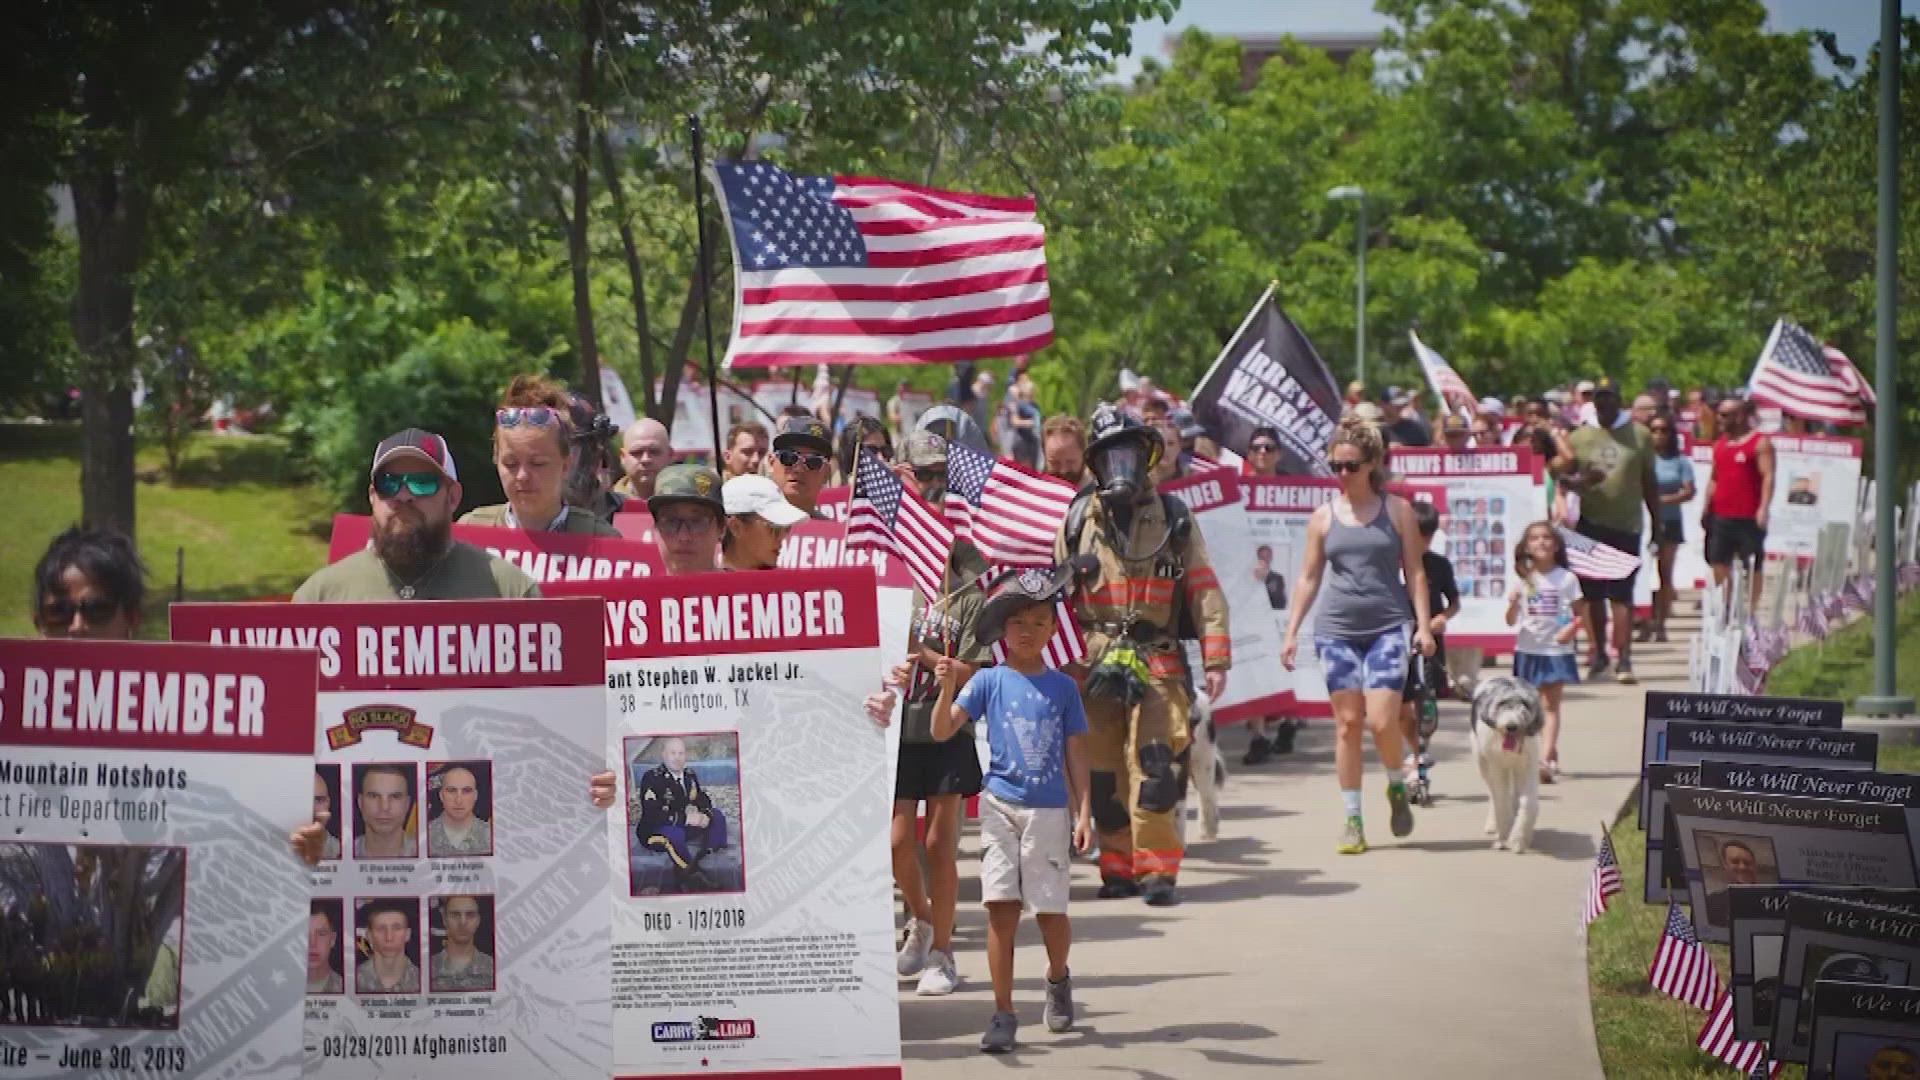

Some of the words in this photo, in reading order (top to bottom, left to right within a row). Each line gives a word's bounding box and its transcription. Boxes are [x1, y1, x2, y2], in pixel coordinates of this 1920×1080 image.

[661, 589, 845, 643] REMEMBER
[357, 623, 563, 677] REMEMBER
[608, 670, 632, 689] ant
[638, 667, 699, 690] Stephen
[704, 664, 721, 683] W.
[728, 661, 778, 684] Jackel
[785, 661, 804, 681] Jr.
[22, 667, 266, 737] REMEMBER
[620, 694, 636, 713] 38
[660, 692, 728, 714] Arlington,
[735, 688, 750, 706] TX
[1667, 699, 1691, 713] We
[1695, 700, 1727, 716] Will
[1730, 702, 1773, 718] Never
[1777, 704, 1823, 723] Forget
[1689, 730, 1715, 744] We
[1721, 732, 1754, 748] Will
[1757, 734, 1803, 751] Never
[1806, 737, 1856, 756] Forget
[0, 759, 89, 787] Mountain
[97, 763, 188, 790] Hotshots
[1726, 770, 1755, 787] We
[1760, 773, 1802, 791] Will
[1802, 777, 1855, 796] Never
[1857, 781, 1912, 802] Forget
[19, 793, 51, 819] Fire
[59, 795, 167, 825] Department
[1693, 797, 1723, 812] We
[1725, 799, 1766, 816] Will
[1768, 802, 1821, 821] Never
[1823, 807, 1881, 828] Forget
[644, 912, 672, 931] DIED
[688, 908, 745, 931] 1/3/2018
[1823, 911, 1860, 929] We
[1866, 918, 1919, 938] Will
[1852, 993, 1891, 1011] We
[653, 1025, 693, 1039] CARRY
[720, 1023, 751, 1037] LOAD
[0, 1042, 27, 1068] ire
[59, 1044, 102, 1070] June
[109, 1045, 136, 1073] 30,
[144, 1046, 186, 1073] 2013
[323, 1034, 408, 1059] 03/29/2011
[413, 1033, 507, 1059] Afghanistan
